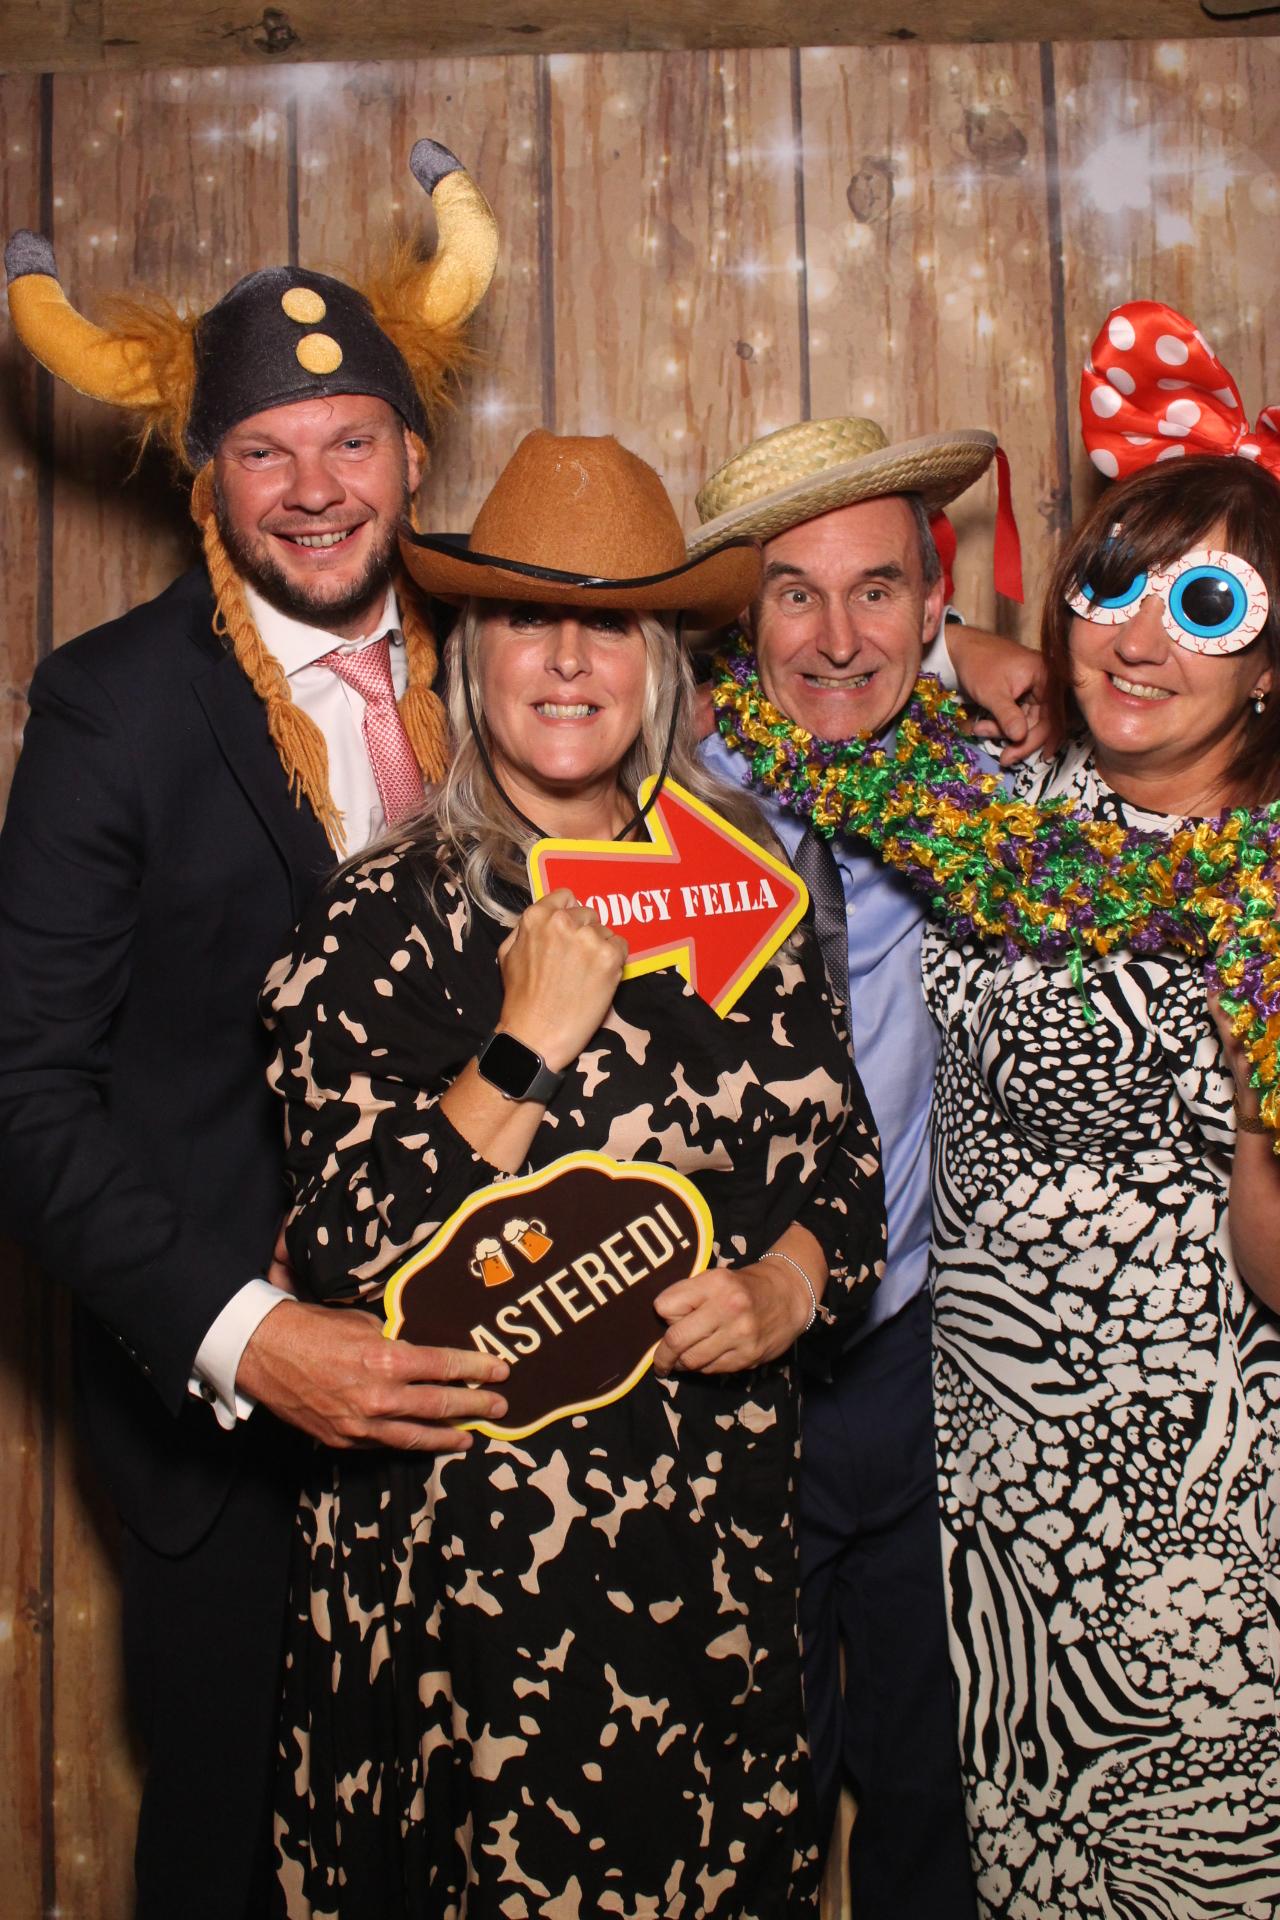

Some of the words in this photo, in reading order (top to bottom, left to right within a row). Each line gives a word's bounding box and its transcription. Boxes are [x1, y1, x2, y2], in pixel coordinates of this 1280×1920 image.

[577, 888, 672, 927] ODGY
[680, 878, 778, 918] FELLA
[466, 1203, 691, 1389] ASTERED!
